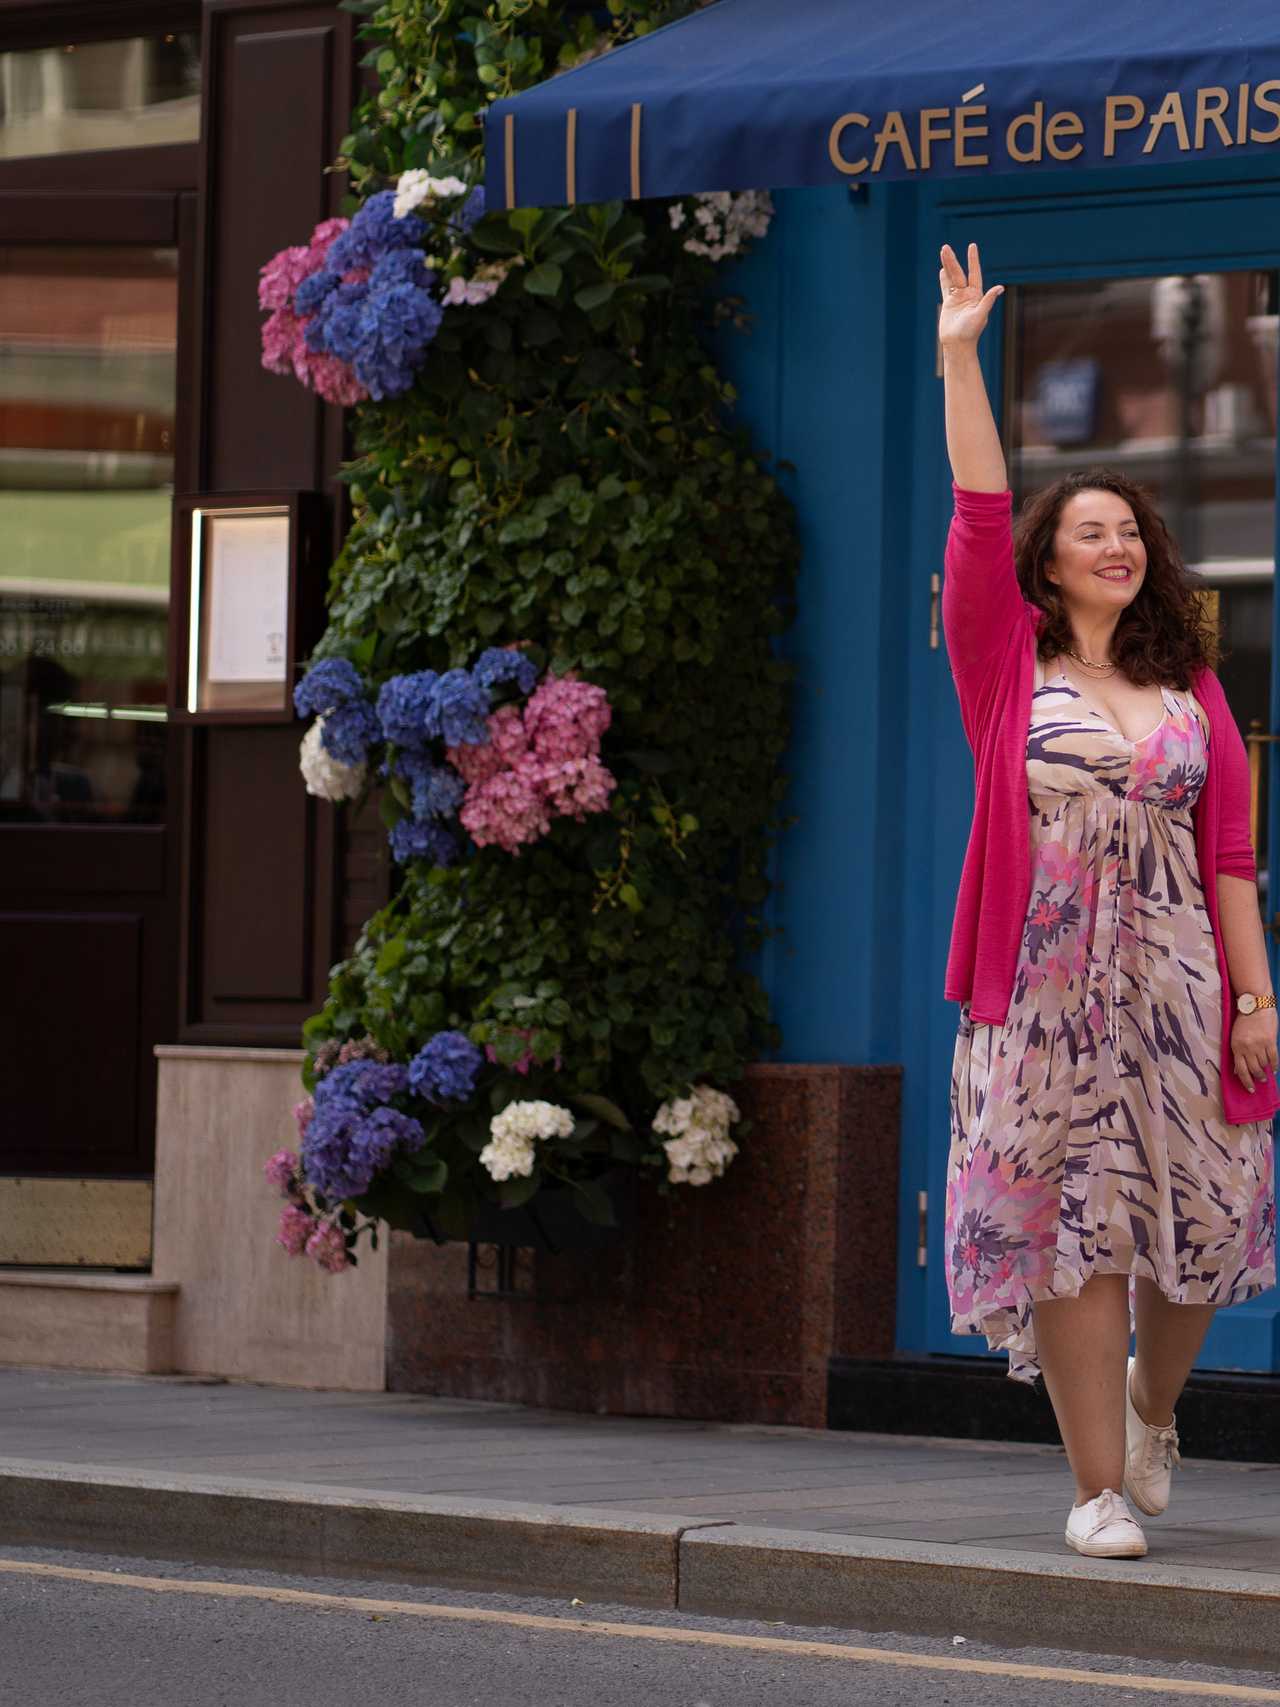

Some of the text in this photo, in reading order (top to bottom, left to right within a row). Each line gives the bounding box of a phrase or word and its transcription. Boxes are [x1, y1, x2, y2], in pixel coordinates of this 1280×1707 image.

[829, 83, 989, 175] CAFÉ
[1006, 101, 1084, 163] de
[34, 639, 85, 657] 24:00
